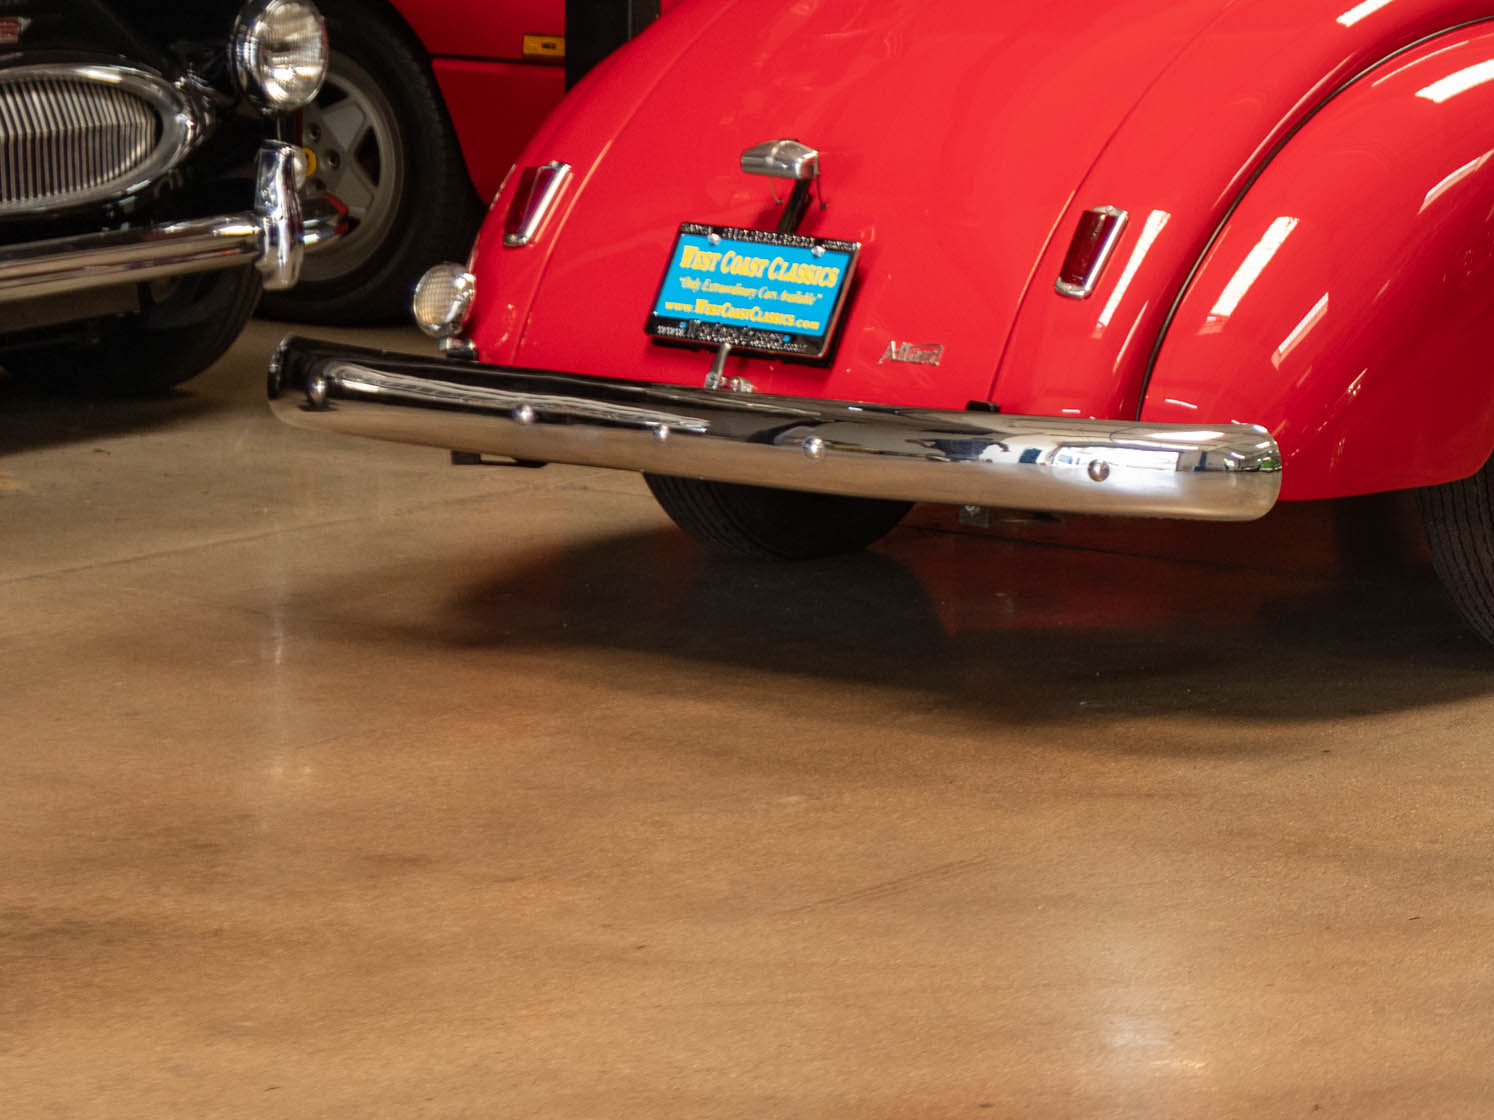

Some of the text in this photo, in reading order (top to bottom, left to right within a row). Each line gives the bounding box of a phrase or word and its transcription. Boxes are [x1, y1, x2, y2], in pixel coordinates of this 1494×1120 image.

[680, 245, 840, 288] WEST COAST CLASSICS
